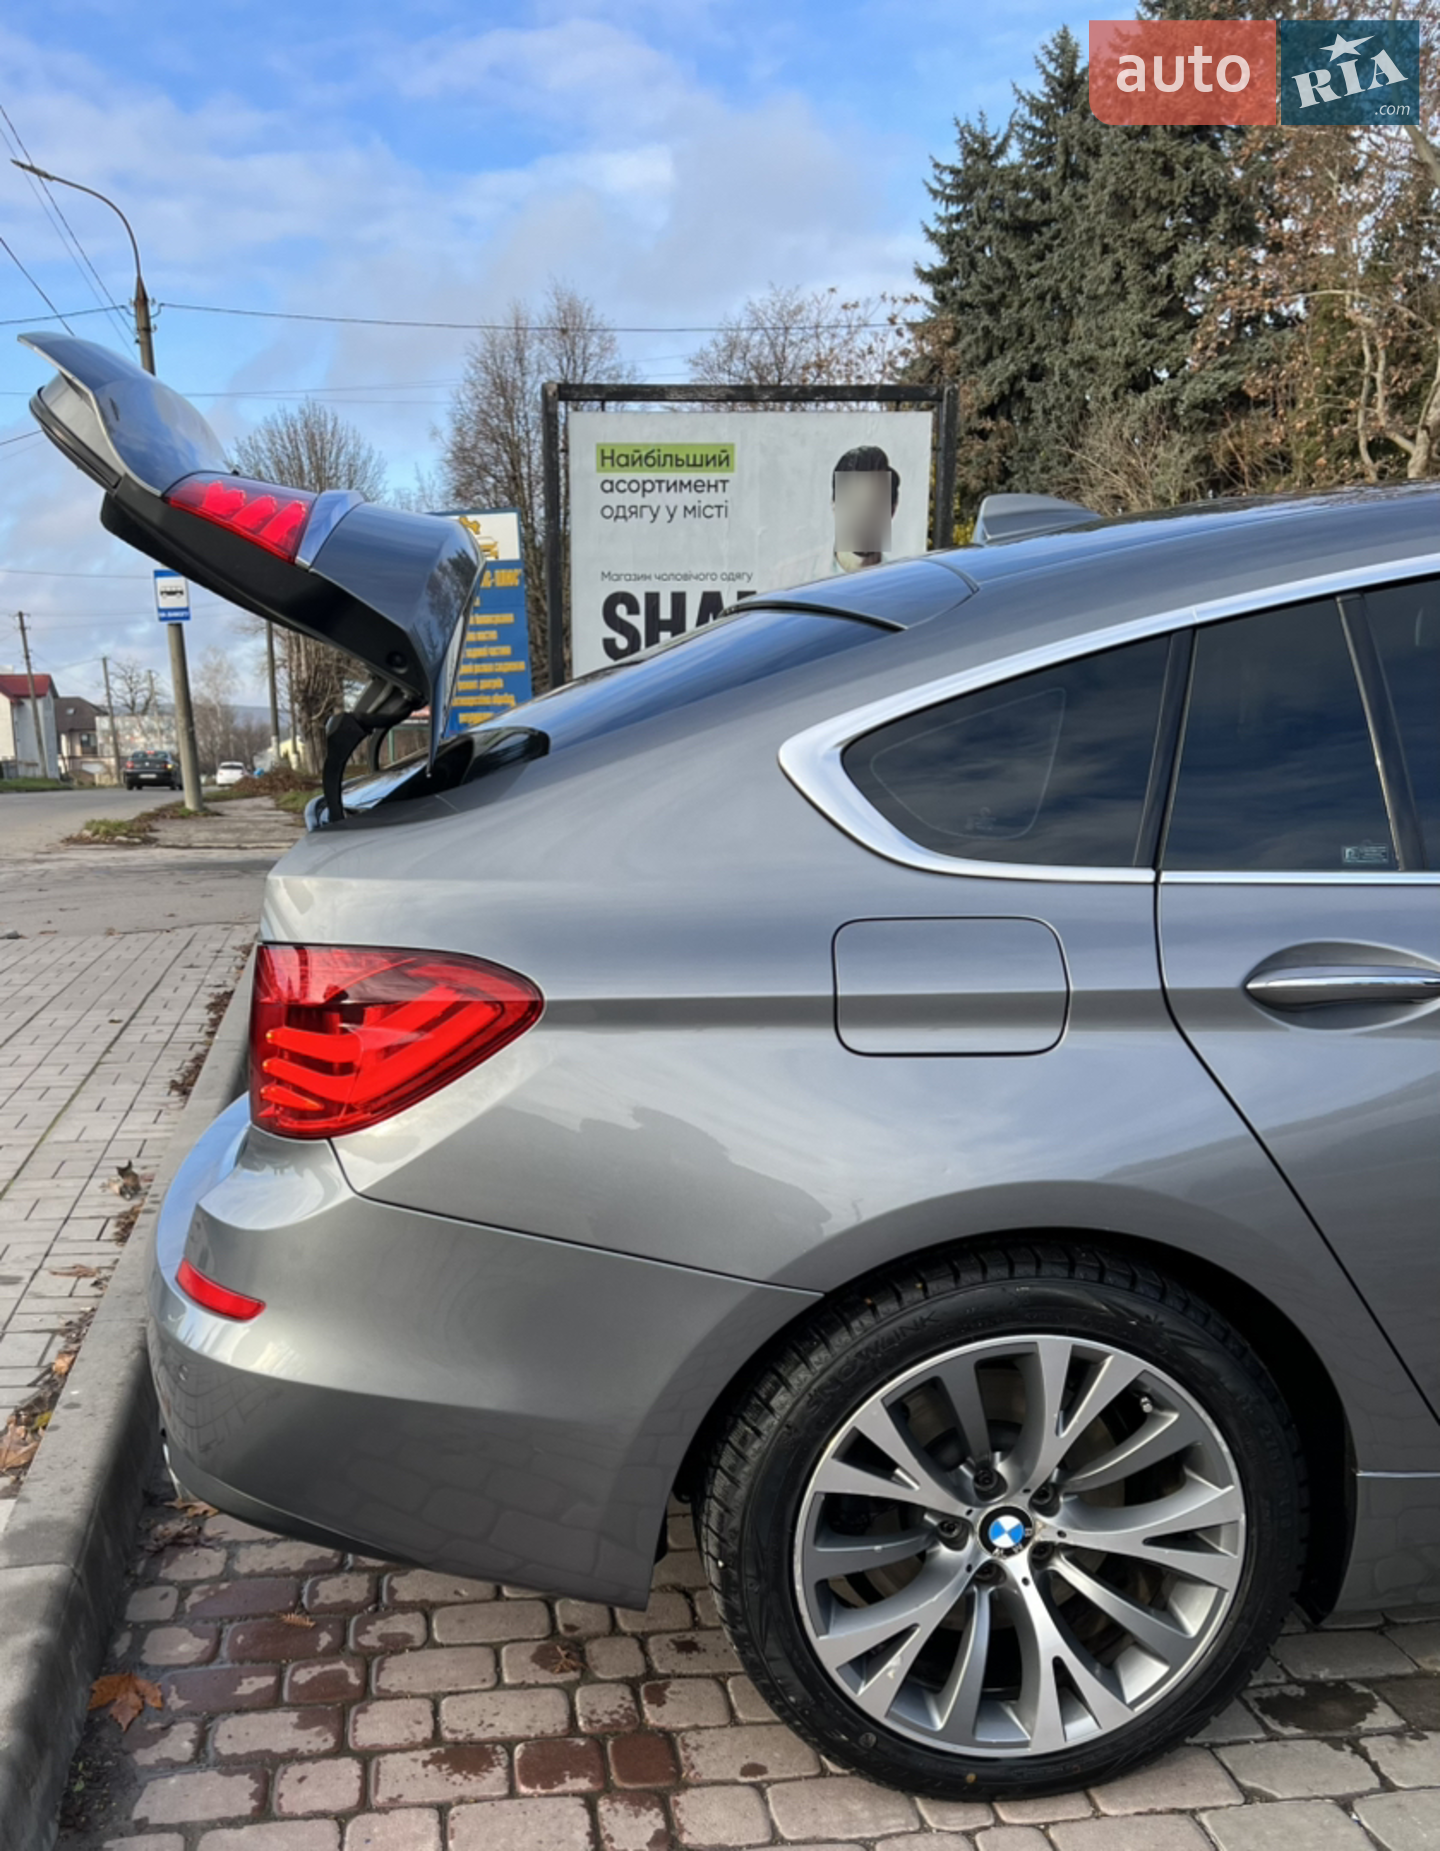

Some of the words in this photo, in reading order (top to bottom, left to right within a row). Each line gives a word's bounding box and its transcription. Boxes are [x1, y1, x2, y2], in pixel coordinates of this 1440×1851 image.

[600, 449, 730, 468] Найбільший
[600, 479, 730, 498] асортимент
[600, 504, 661, 523] одягу
[665, 505, 678, 523] у
[683, 500, 728, 519] місті
[600, 571, 651, 582] Магазин
[654, 571, 718, 582] чоловічого
[720, 571, 753, 583] одягу
[602, 591, 757, 661] SHA
